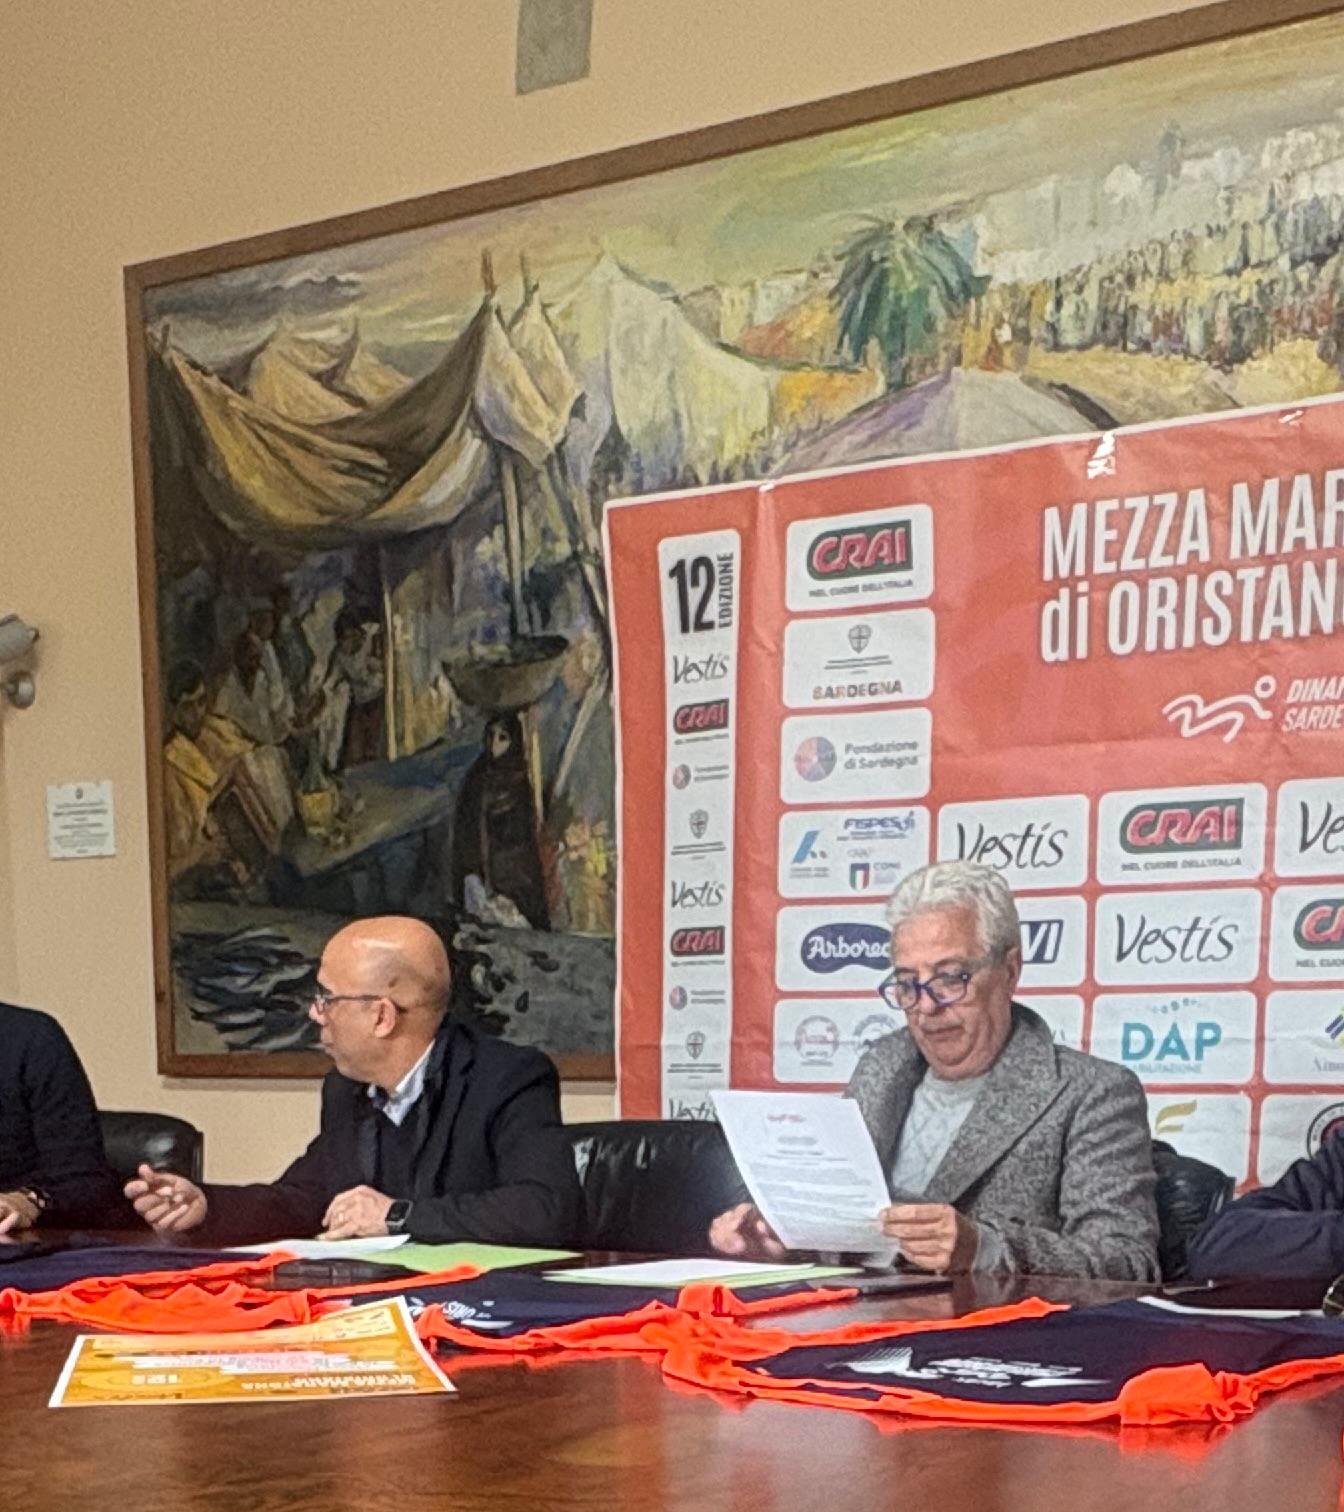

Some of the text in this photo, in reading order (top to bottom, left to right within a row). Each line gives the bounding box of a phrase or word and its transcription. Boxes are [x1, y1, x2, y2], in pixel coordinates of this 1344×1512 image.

[812, 525, 908, 574] CRAI
[1041, 487, 1212, 583] MEZZA
[668, 554, 717, 635] 12
[717, 551, 735, 628] EDIZIONE
[1040, 580, 1089, 664] di
[672, 652, 730, 685] Vestis
[813, 680, 903, 700] SARDEGNA
[957, 821, 1069, 871] Vestis
[1126, 804, 1238, 848] CRAI
[670, 880, 725, 909] Vestis
[1116, 912, 1239, 965] Vestis
[1120, 1021, 1222, 1063] DAP
